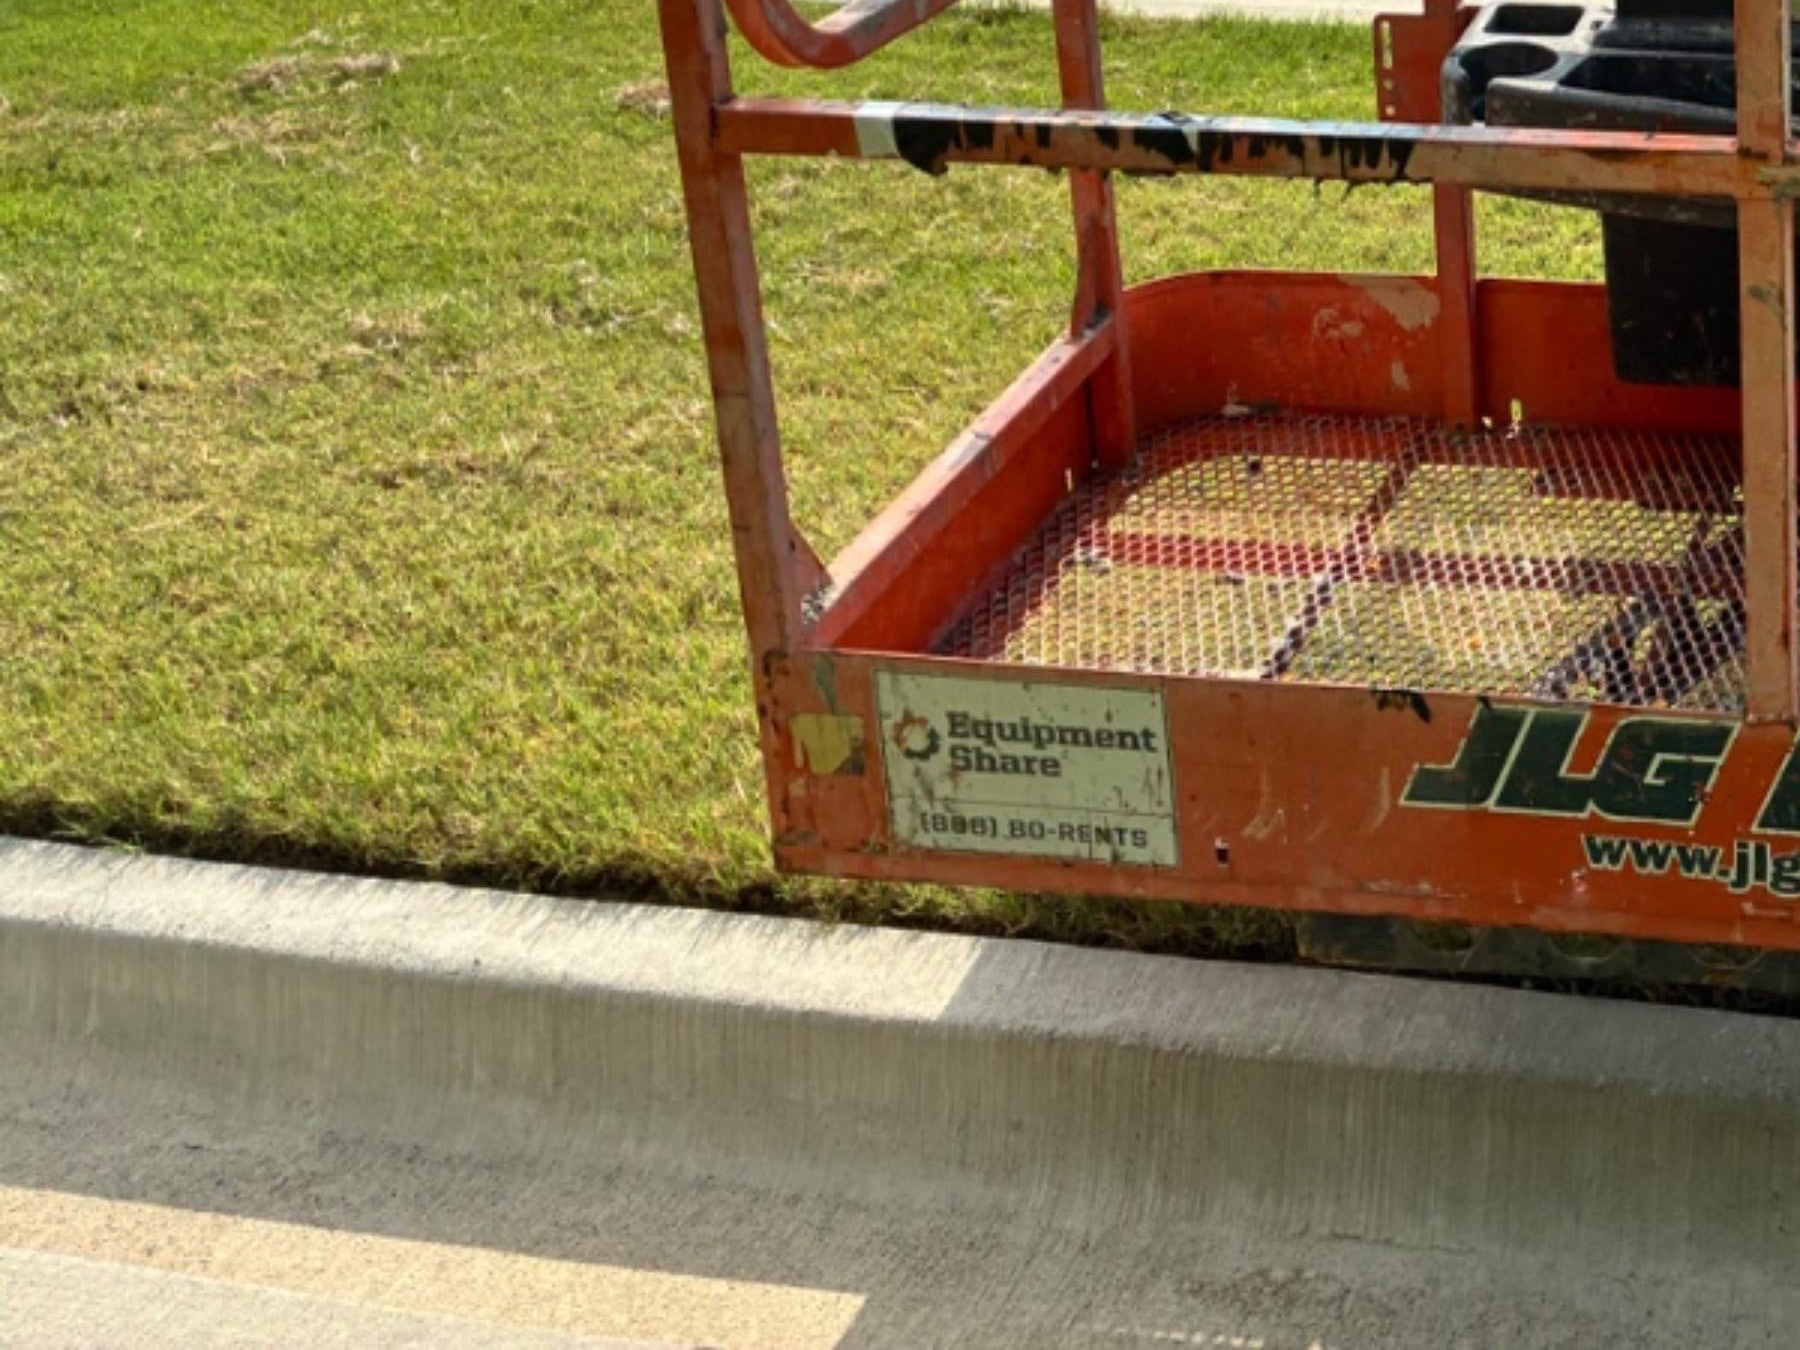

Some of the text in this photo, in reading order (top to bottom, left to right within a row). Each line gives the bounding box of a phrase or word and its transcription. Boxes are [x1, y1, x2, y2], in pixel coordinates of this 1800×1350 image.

[945, 710, 1159, 754] Equipment
[949, 744, 1062, 778] Share
[1398, 702, 1743, 827] JLG
